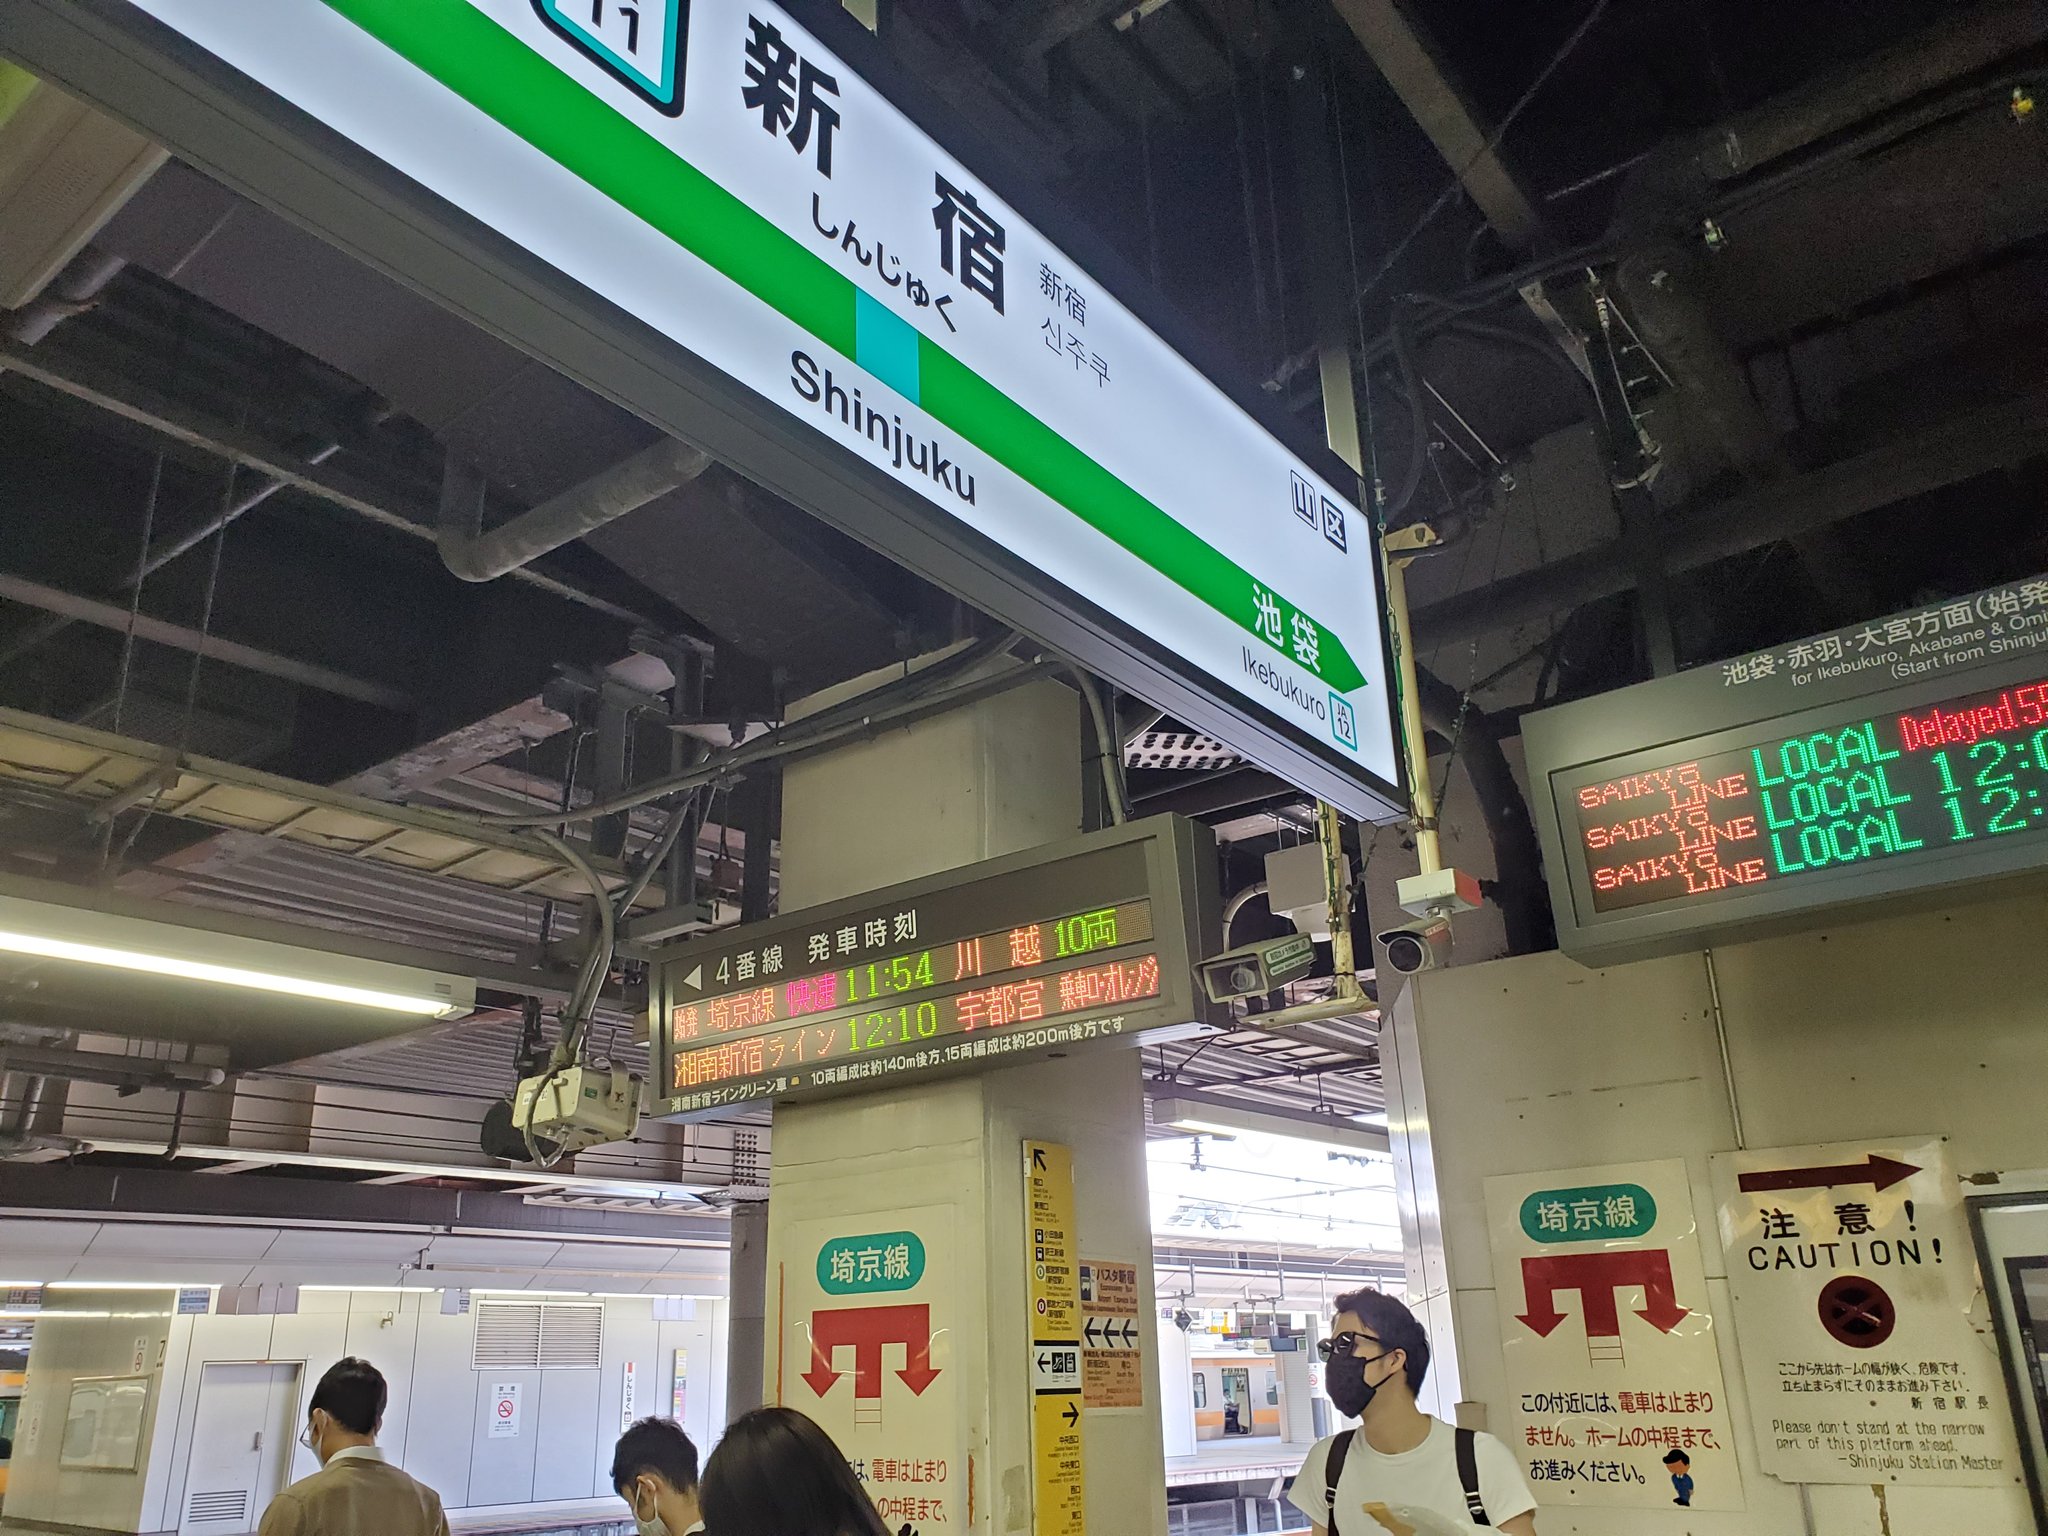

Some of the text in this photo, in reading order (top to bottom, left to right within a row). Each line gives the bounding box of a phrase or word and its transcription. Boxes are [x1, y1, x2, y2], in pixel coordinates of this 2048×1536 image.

[741, 13, 1006, 317] 新宿
[812, 192, 957, 333] しんじゅく
[1039, 262, 1087, 327] 新宿
[1040, 315, 1112, 389] 신주쿠
[789, 349, 977, 507] Shinjuku
[1252, 583, 1321, 674] 池袋
[1791, 609, 2048, 687] for Ikebukuro, Akabane & Ōmi
[1242, 645, 1326, 721] Ikebukuro
[1891, 656, 1941, 680] (Start
[1944, 647, 1985, 666] from
[1336, 702, 1348, 720] JA
[1338, 716, 1352, 740] 12
[1900, 693, 2018, 751] Delayed
[1752, 721, 1900, 788] LOCAL
[1668, 774, 1748, 810] LINE
[1762, 765, 1911, 830] LOCAL
[1676, 816, 1757, 852] LINE
[1771, 810, 1923, 873] LOCAL
[1685, 858, 1767, 894] LINE
[716, 909, 917, 985] 4番線 発車時刻
[707, 987, 776, 1031] 埼京線
[786, 973, 837, 1017] 快速
[846, 951, 934, 1002] 11:54
[954, 924, 1042, 981] 川越
[1055, 909, 1117, 957] 10両
[674, 1029, 836, 1088] 湘南新宿ライン
[848, 1001, 937, 1051] 12:10
[956, 979, 1043, 1031] 宇都宮
[671, 1077, 787, 1113] 湘南新宿ライングリーン車
[1537, 1195, 1639, 1233] 埼京線
[831, 1243, 911, 1284] 埼京線
[1748, 1238, 1942, 1271] CAUTION!
[1521, 1391, 1713, 1415] この付近には、電車は止まり
[1772, 1419, 1985, 1436] Please don't stand at the narrow
[1776, 1438, 1801, 1451] part
[1808, 1437, 1820, 1450] of
[1828, 1437, 1854, 1451] this
[1860, 1438, 1913, 1453] platform
[847, 1458, 947, 1482] は、電車は止まり
[1530, 1459, 1645, 1485] お進みください。
[1909, 1455, 1956, 1471] Station
[1961, 1456, 2003, 1471] Master
